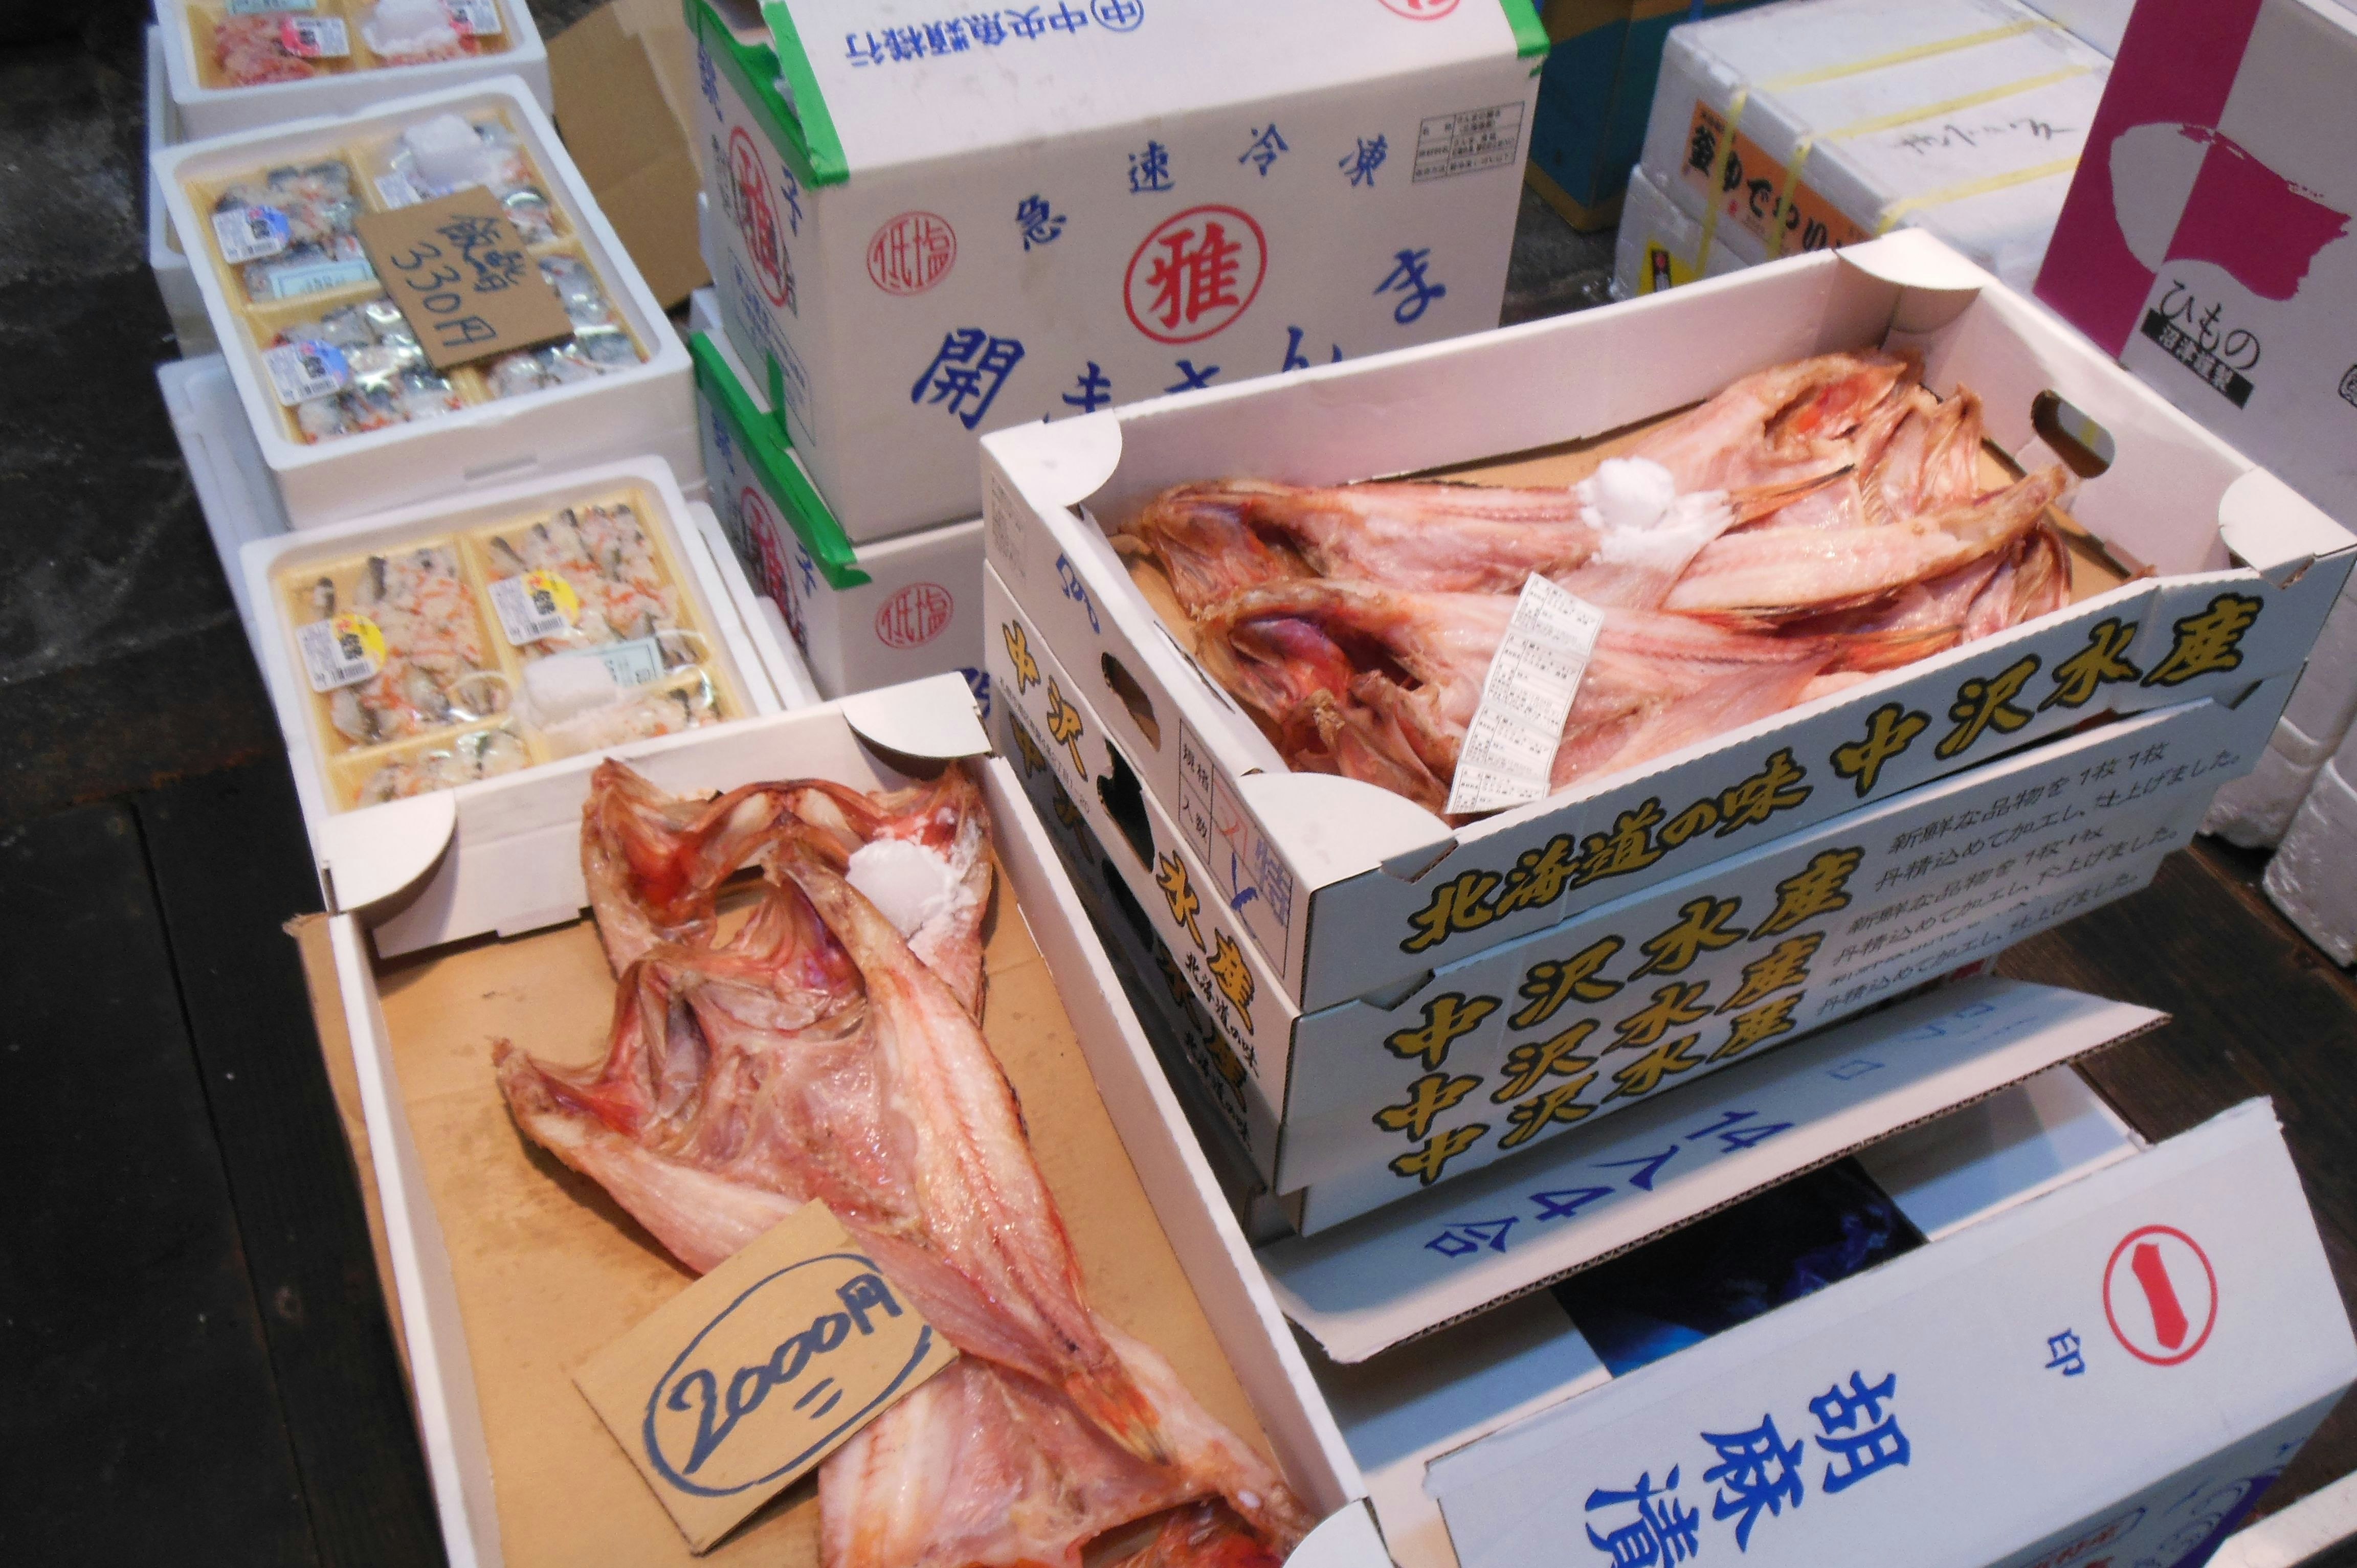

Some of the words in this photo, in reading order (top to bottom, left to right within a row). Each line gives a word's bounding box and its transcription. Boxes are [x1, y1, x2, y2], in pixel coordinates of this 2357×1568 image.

[391, 242, 498, 348] 330円
[1145, 220, 1244, 331] 雅
[2160, 279, 2260, 370] ひもの
[1399, 746, 1814, 955] 北海道の味
[1830, 592, 2264, 798] 中沢水産
[1372, 929, 1826, 1143] 中沢水産
[1383, 845, 1865, 1071] 中沢水産
[1389, 990, 1807, 1186] 中沢水産
[665, 1273, 903, 1475] 2000円
[2045, 1327, 2086, 1376] 印
[1584, 1369, 1911, 1568] 胡麻漬
